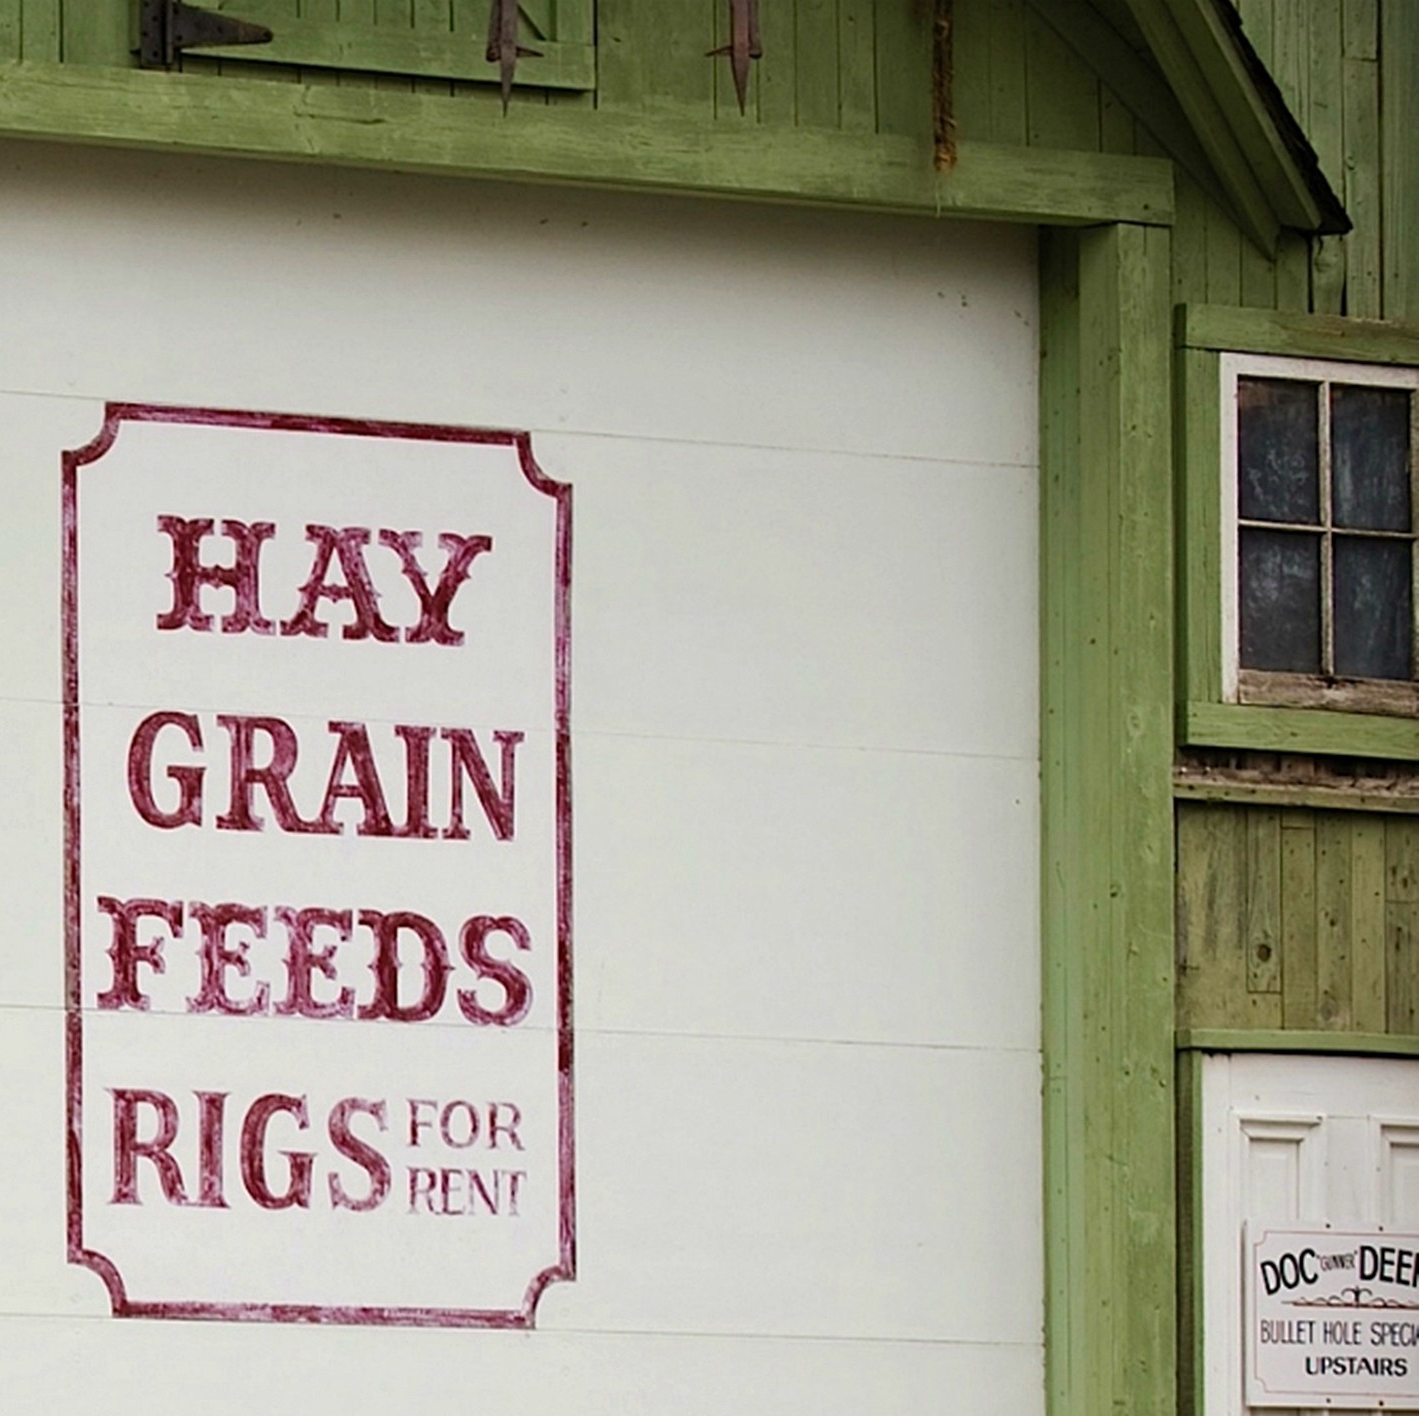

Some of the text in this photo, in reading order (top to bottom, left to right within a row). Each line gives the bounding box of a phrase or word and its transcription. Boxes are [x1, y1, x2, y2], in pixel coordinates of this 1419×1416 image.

[156, 514, 493, 647] HAY
[126, 710, 525, 842] GRAIN
[96, 895, 533, 1027] FEEDS
[105, 1086, 526, 1213] RIGS FOR
[406, 1165, 528, 1217] RENT
[1260, 1248, 1319, 1296] DOC
[1260, 1319, 1419, 1348] BULLET HOLE SPECI
[1305, 1356, 1409, 1378] UPSTAIRS
